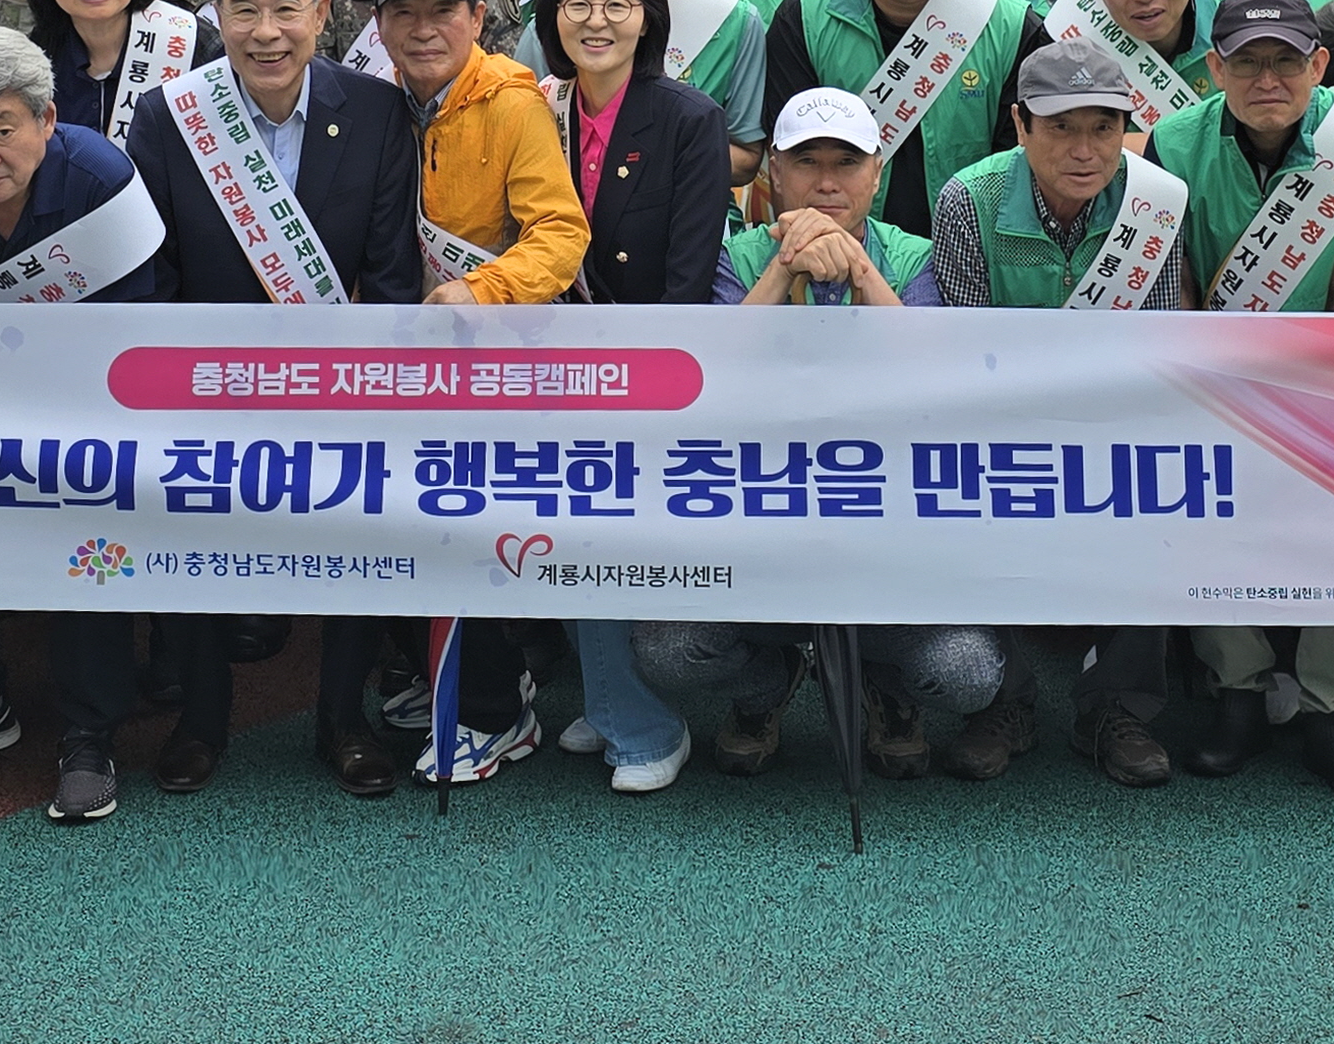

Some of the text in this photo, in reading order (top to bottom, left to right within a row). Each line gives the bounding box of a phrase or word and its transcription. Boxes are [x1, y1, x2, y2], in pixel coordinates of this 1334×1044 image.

[1138, 55, 1173, 91] 실천
[880, 51, 953, 145] 충청남도
[204, 66, 250, 141] 탄소중립
[243, 149, 281, 195] 실천
[175, 91, 269, 248] 따뜻한 자원봉사
[192, 361, 631, 398] 충청남도 자원봉사 공동캠페인
[158, 437, 390, 515] 참여가
[413, 438, 637, 518] 행복한
[662, 439, 886, 518] 충남을
[911, 441, 1235, 519] 만듭니다!
[145, 552, 416, 581] (사) 충청남도자원봉사센터
[537, 563, 733, 590] 계룡시자원봉사센터
[1188, 587, 1200, 600] 이
[1202, 587, 1244, 600] 현수막은
[1246, 587, 1289, 600] 탄소중립
[1291, 587, 1323, 600] 실현을
